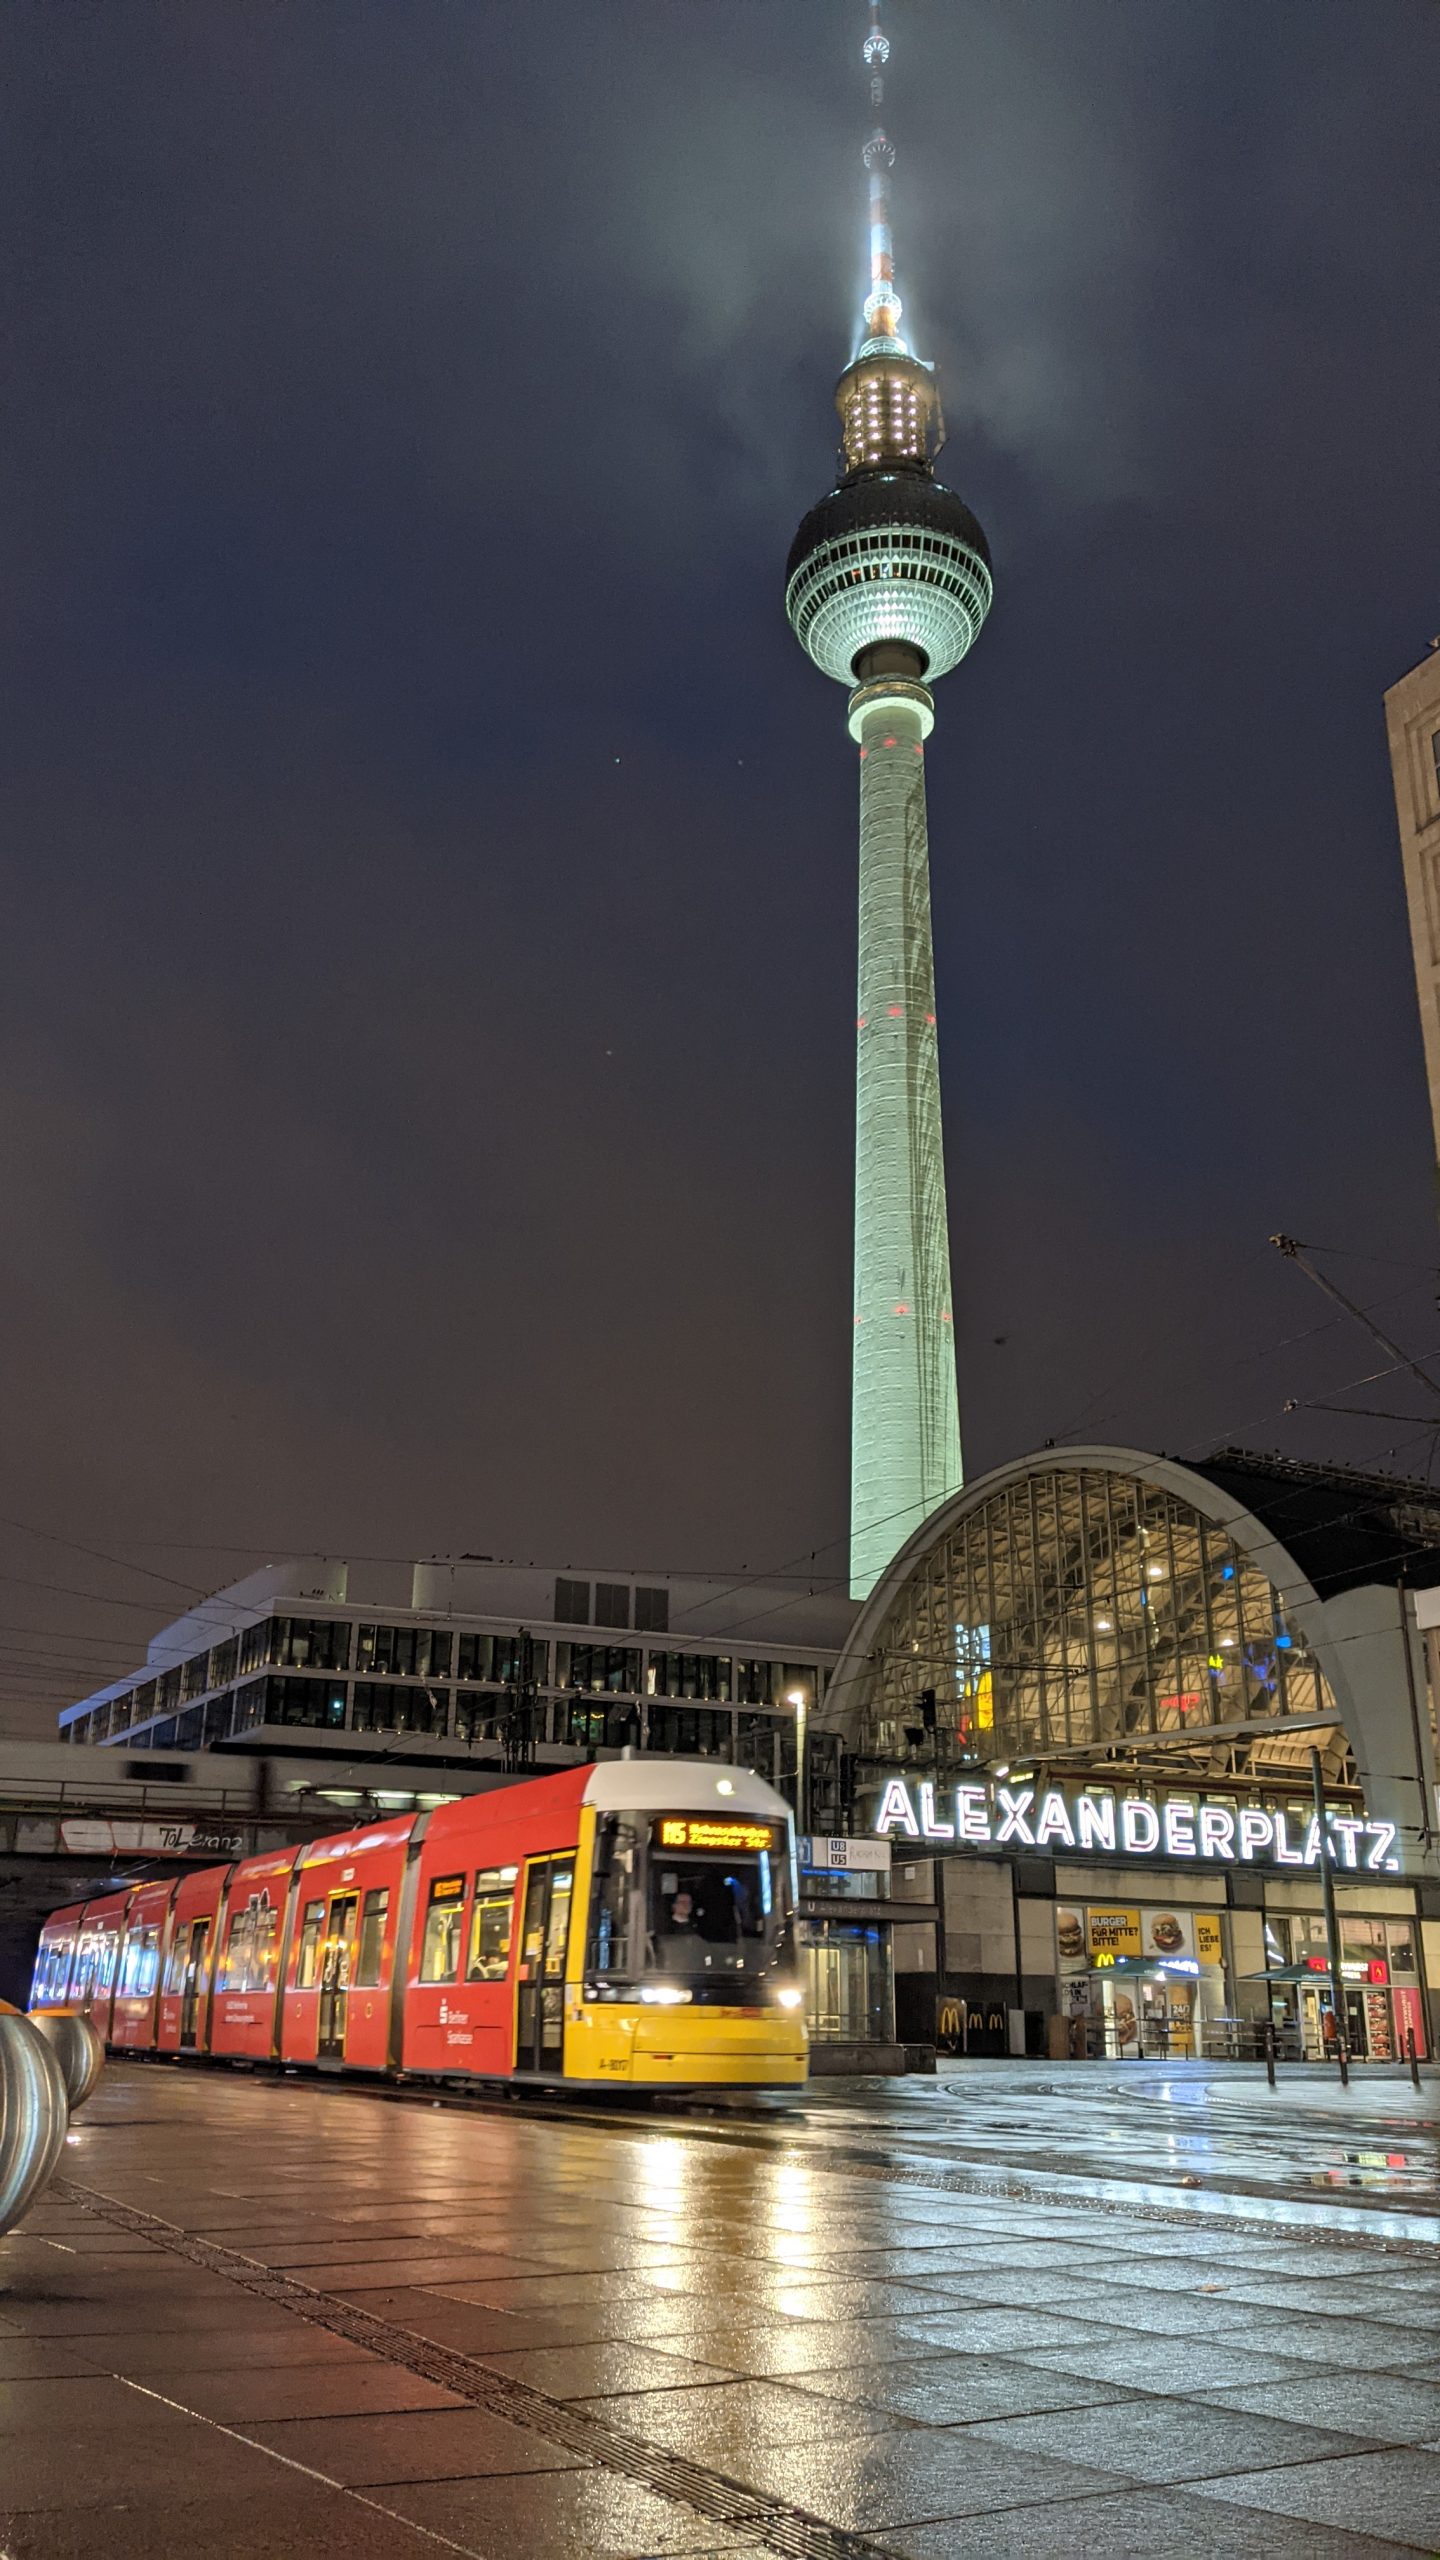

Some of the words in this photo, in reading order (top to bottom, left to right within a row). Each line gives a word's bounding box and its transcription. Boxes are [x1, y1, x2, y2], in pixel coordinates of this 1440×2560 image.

[876, 1779, 1399, 1871] ALEXANDERPLATZ
[832, 1841, 847, 1851] U8
[832, 1855, 847, 1865] U5
[1090, 1916, 1127, 1927] BURGER
[1108, 1927, 1139, 1938] MITTE?
[1198, 1927, 1211, 1936] ICH
[1092, 1937, 1119, 1947] BITTE!
[1199, 1935, 1219, 1944] LIEBE
[1200, 1944, 1212, 1952] ES!
